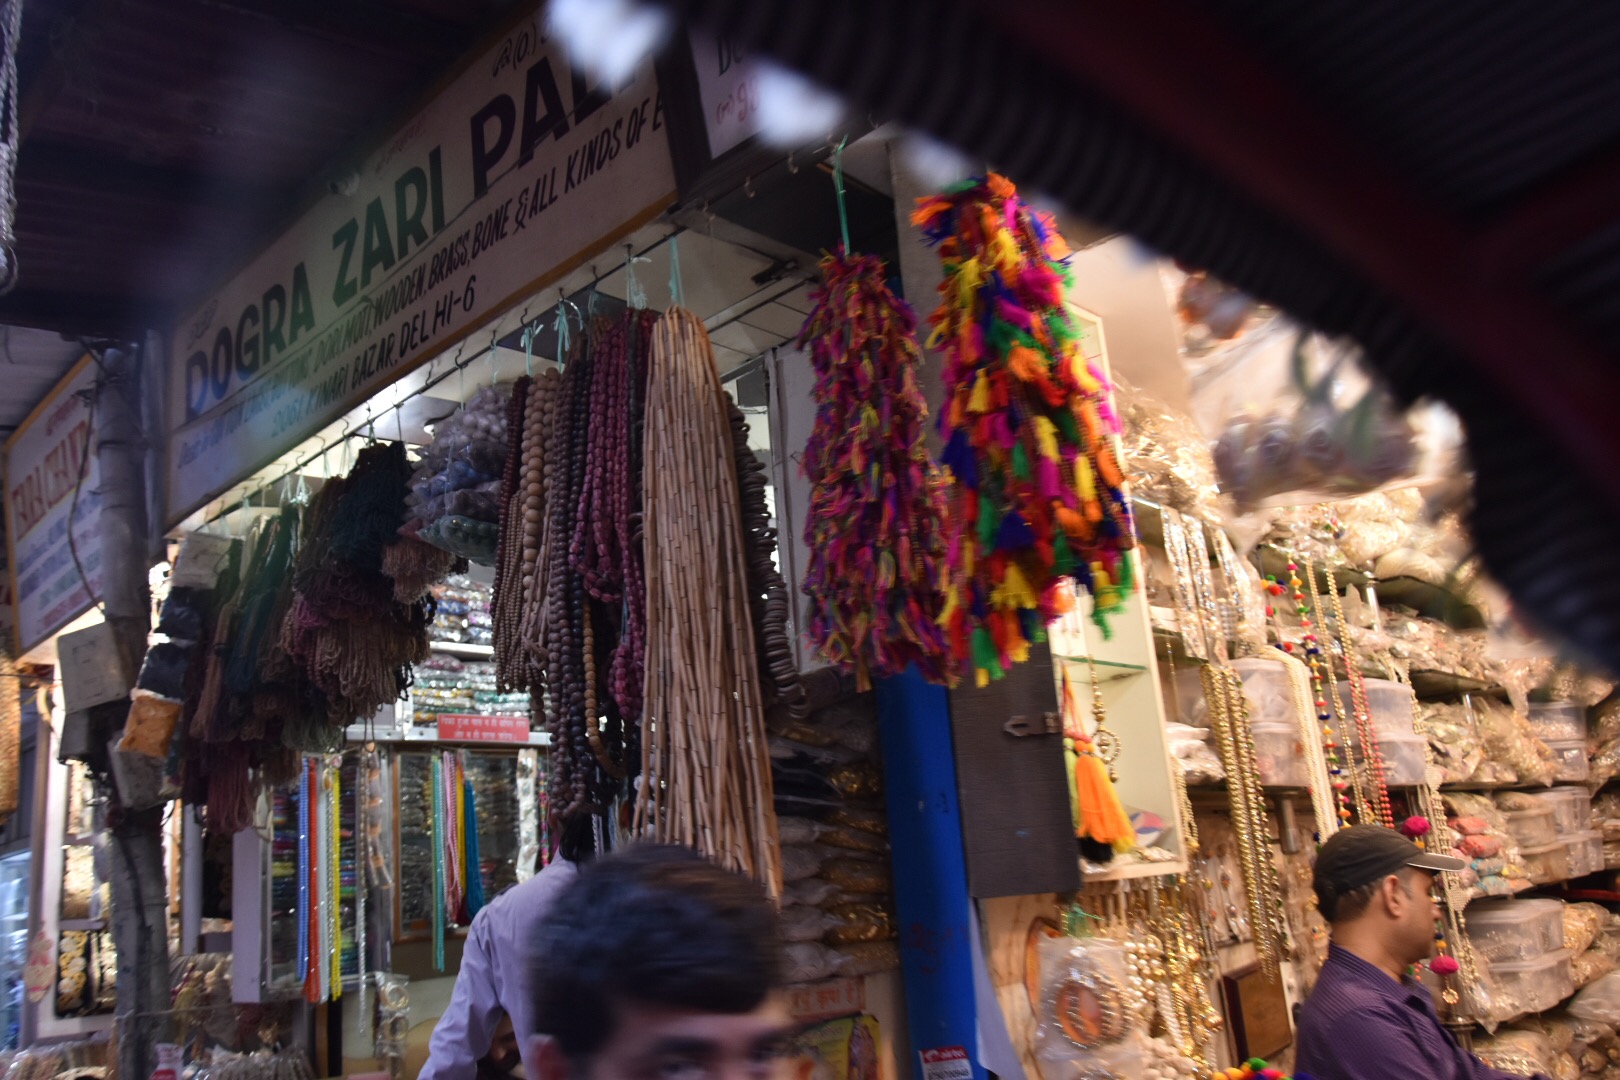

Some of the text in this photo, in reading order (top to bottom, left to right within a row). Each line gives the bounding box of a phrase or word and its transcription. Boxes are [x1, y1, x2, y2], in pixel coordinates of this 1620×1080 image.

[185, 262, 315, 424] DOGRA
[332, 145, 446, 307] ZARI
[471, 198, 512, 259] BONE
[512, 187, 529, 235] &
[529, 167, 558, 219] ALL
[564, 117, 623, 194] KINDS
[626, 98, 650, 149] OF
